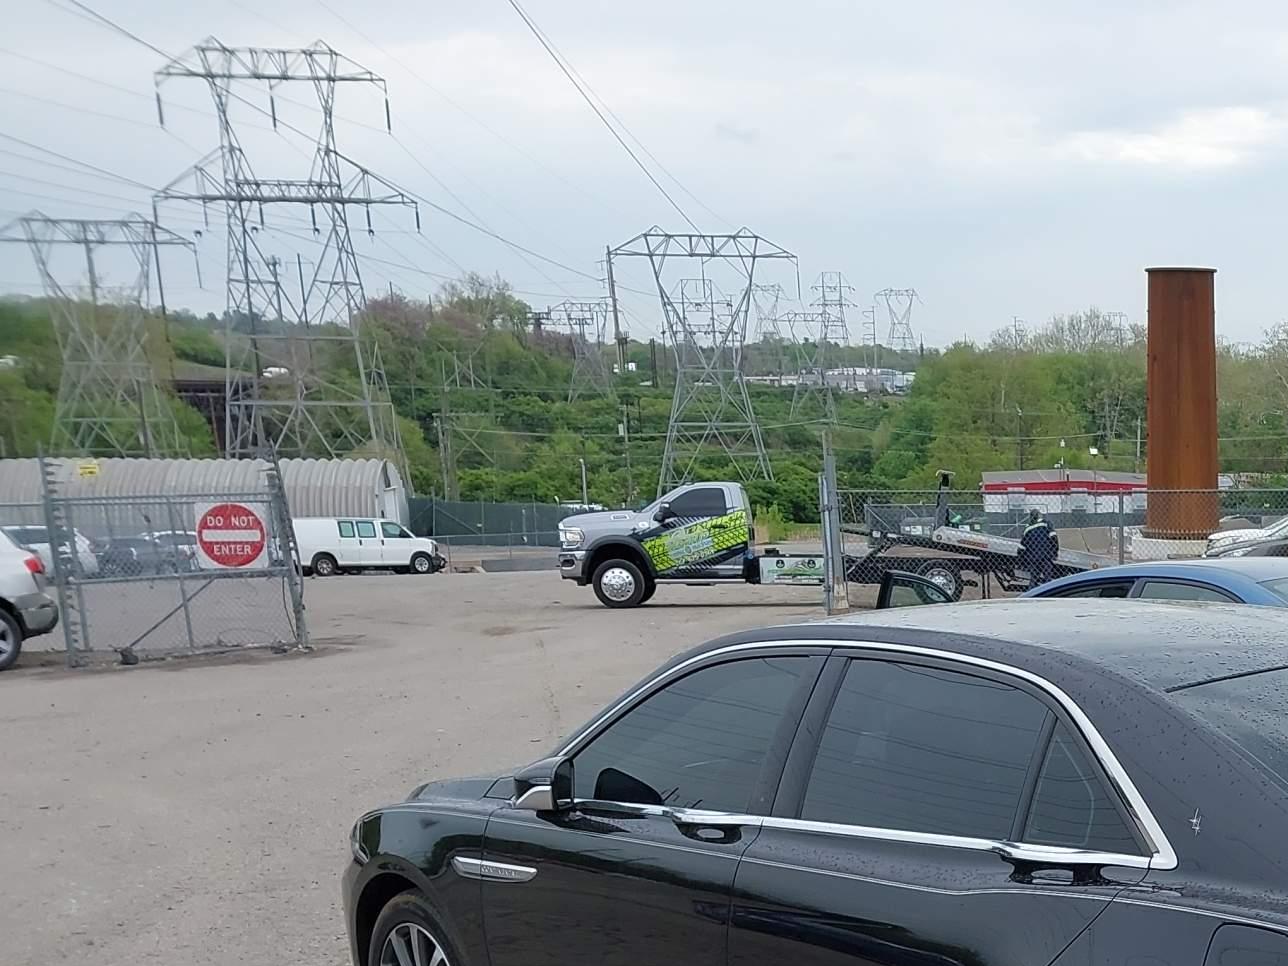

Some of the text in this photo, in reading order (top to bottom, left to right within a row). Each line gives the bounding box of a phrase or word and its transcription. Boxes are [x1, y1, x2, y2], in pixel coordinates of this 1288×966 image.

[206, 516, 255, 527] DO NOT
[213, 544, 252, 555] ENTER
